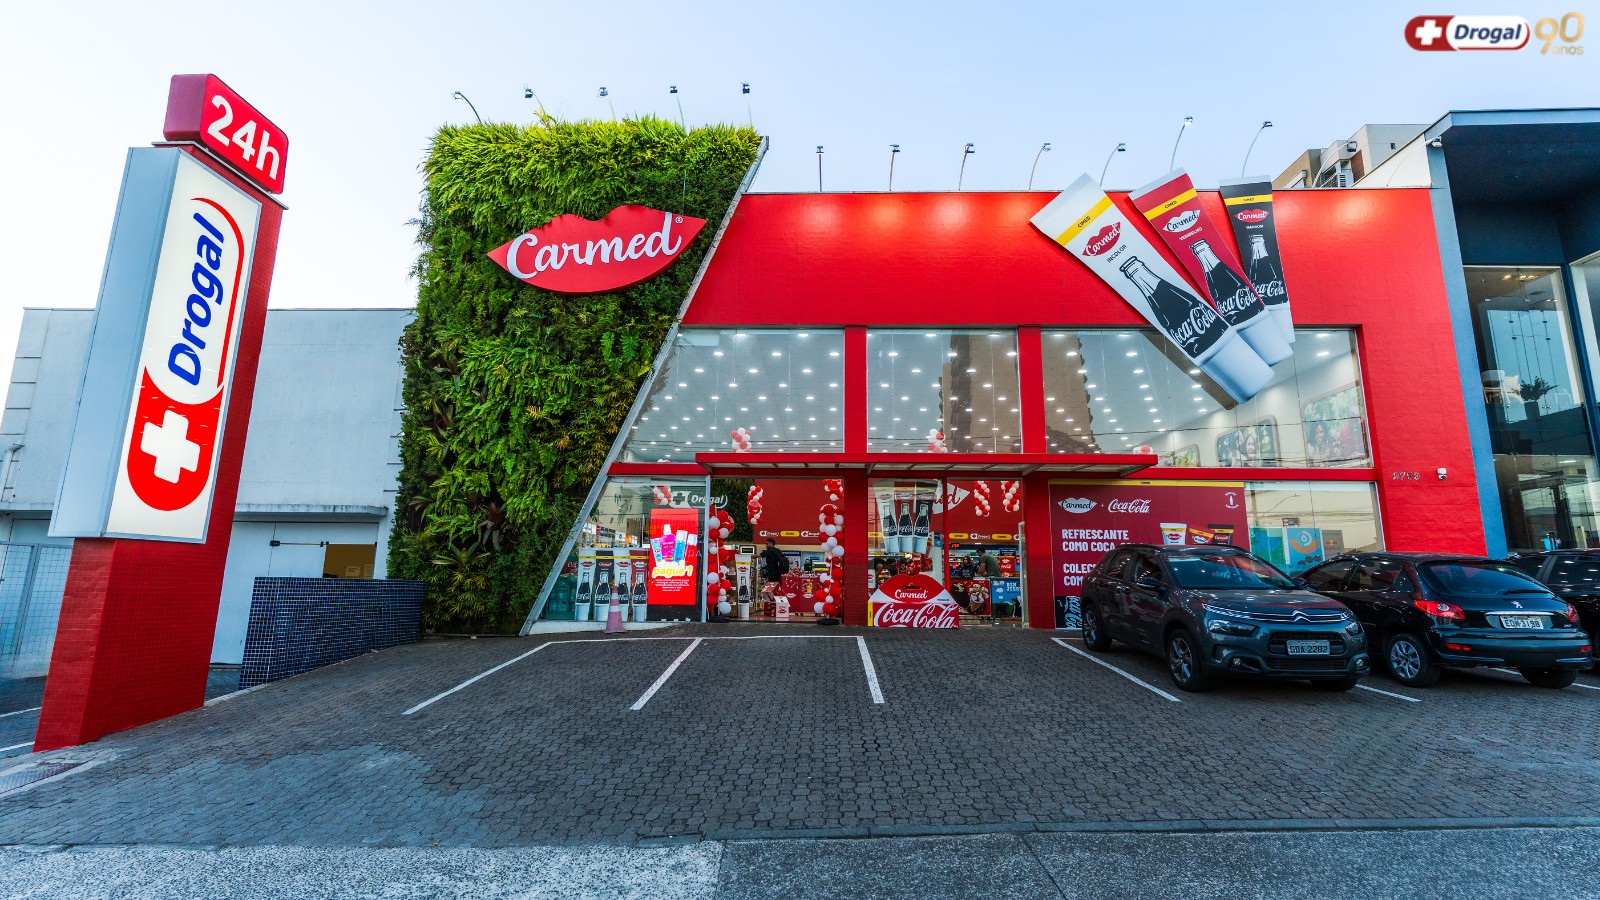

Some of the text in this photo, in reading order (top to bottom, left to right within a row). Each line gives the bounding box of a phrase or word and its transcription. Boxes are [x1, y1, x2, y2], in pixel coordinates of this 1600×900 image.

[207, 94, 280, 181] 24h
[1077, 216, 1091, 228] CIMED
[1167, 211, 1198, 232] Carmed
[1238, 210, 1267, 221] Carmed
[506, 211, 682, 279] Carmed
[1086, 224, 1120, 256] Carmed
[1106, 244, 1127, 263] INCOLOR
[167, 212, 225, 387] Drogal
[1061, 500, 1094, 510] Carmed
[1108, 498, 1152, 514] Coca-Cola
[1061, 529, 1129, 540] REFRESCANTE
[1062, 541, 1088, 552] COMO
[653, 565, 693, 577] pague 1
[894, 589, 928, 599] Carmed
[873, 603, 958, 629] Coca-Cola
